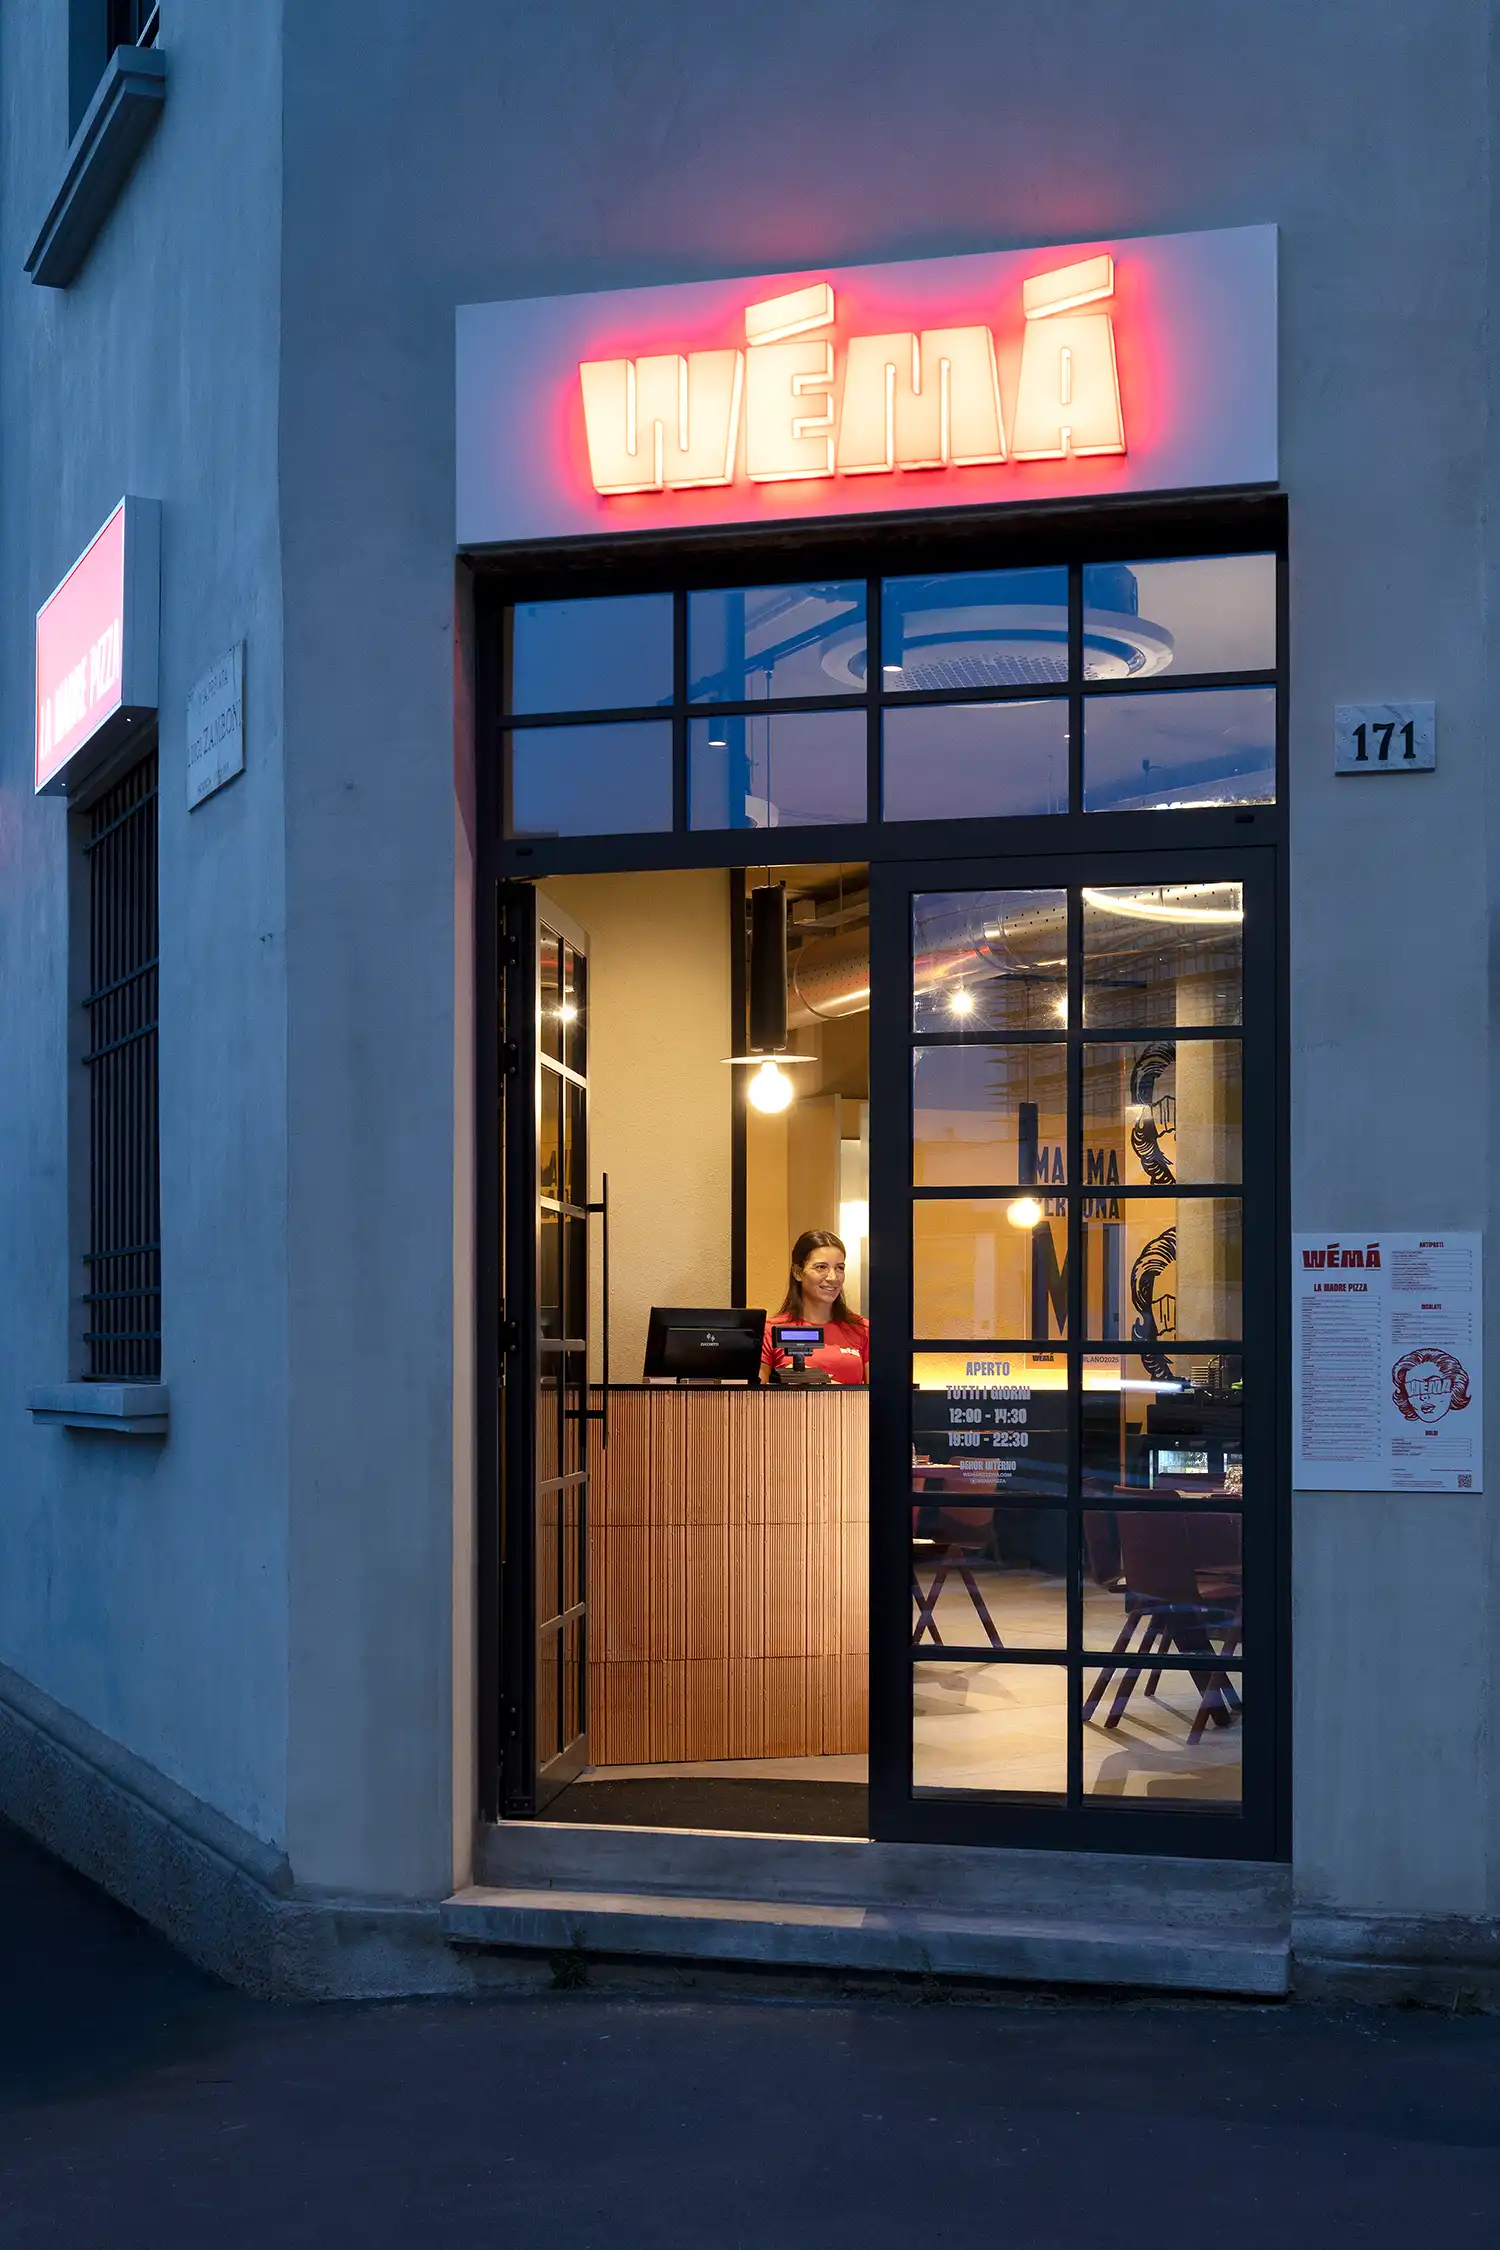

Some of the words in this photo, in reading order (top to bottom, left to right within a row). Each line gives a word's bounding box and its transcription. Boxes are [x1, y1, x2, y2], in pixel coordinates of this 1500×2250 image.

[579, 253, 1128, 498] WÉMÁ
[1352, 720, 1416, 761] 171
[1303, 1243, 1381, 1268] WÉMÁ
[1313, 1283, 1322, 1292] LA
[1323, 1283, 1347, 1292] MADRE
[1348, 1283, 1368, 1292] PIZZA
[965, 1361, 1011, 1376] APERTO
[946, 1385, 980, 1400] TUTTI
[982, 1385, 988, 1400] I
[990, 1385, 1031, 1400] GIORNI
[949, 1407, 982, 1424] 12:00
[994, 1407, 1028, 1424] 14:30
[992, 1431, 1029, 1448] 22:30
